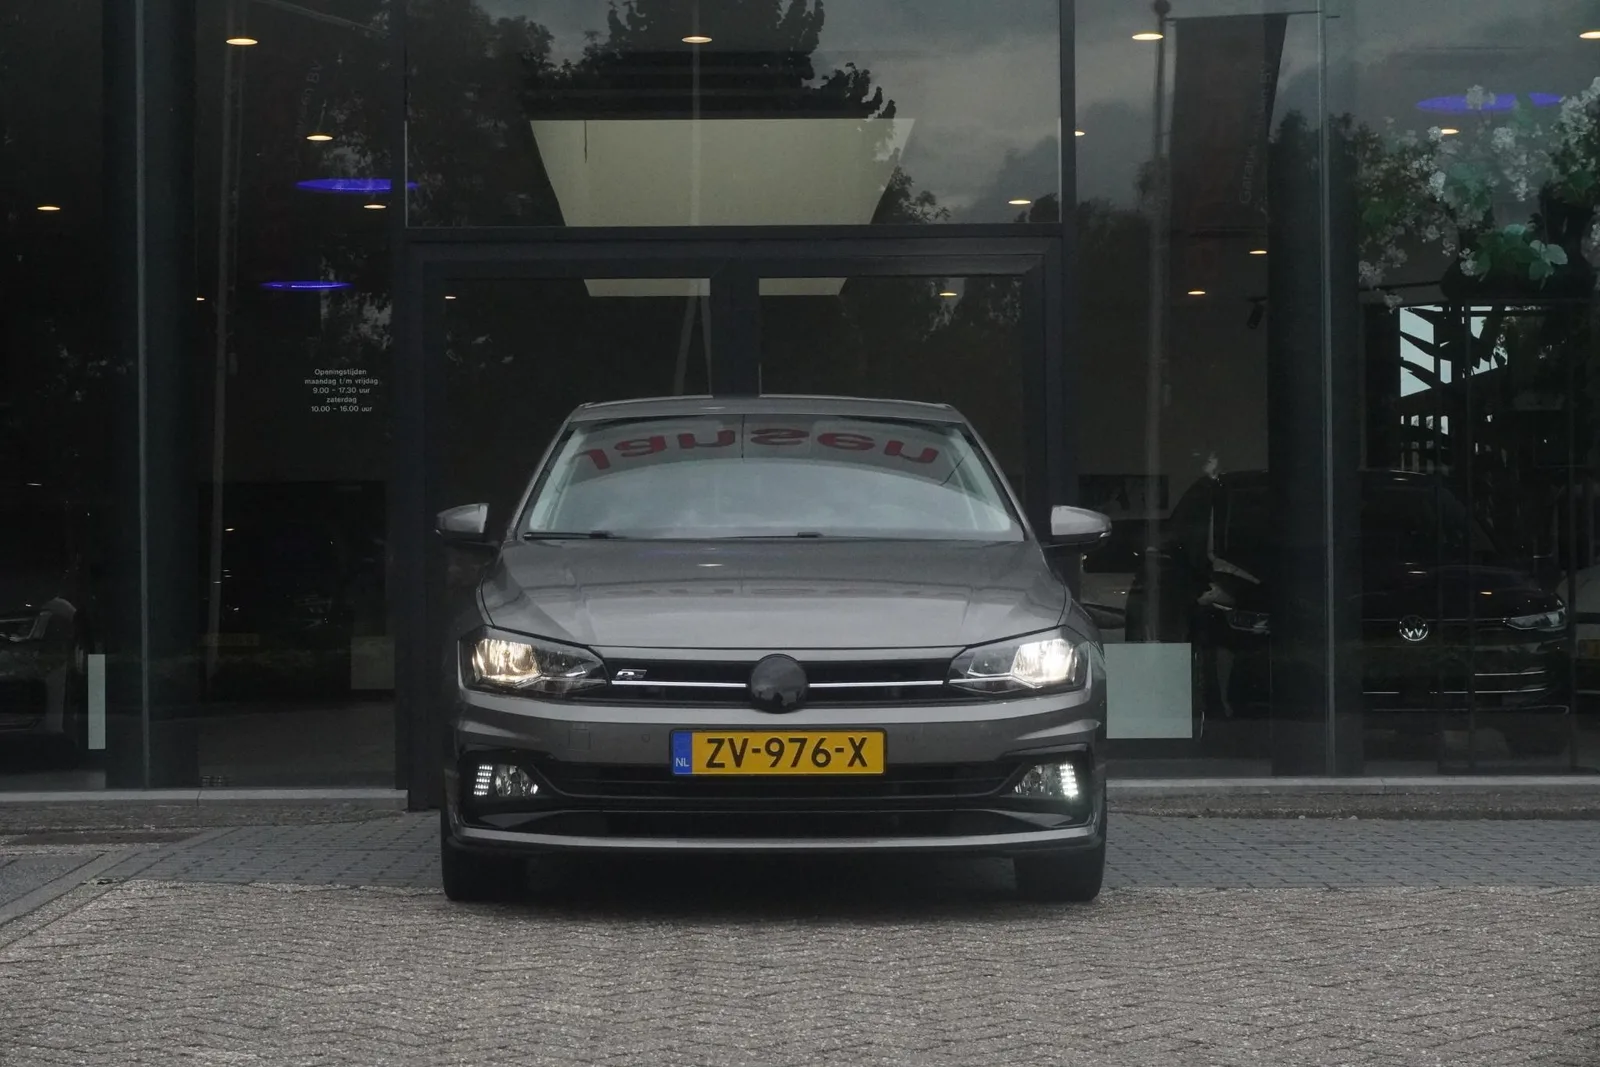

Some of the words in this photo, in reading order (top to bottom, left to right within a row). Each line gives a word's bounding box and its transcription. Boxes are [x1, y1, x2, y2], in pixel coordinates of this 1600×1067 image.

[314, 368, 367, 376] Openingstijden
[304, 378, 337, 386] maandag
[339, 377, 353, 385] t/m
[354, 377, 379, 386] vrijdag
[326, 396, 357, 404] zaterdag
[705, 737, 868, 769] ZV-976-X
[675, 757, 690, 768] NL
